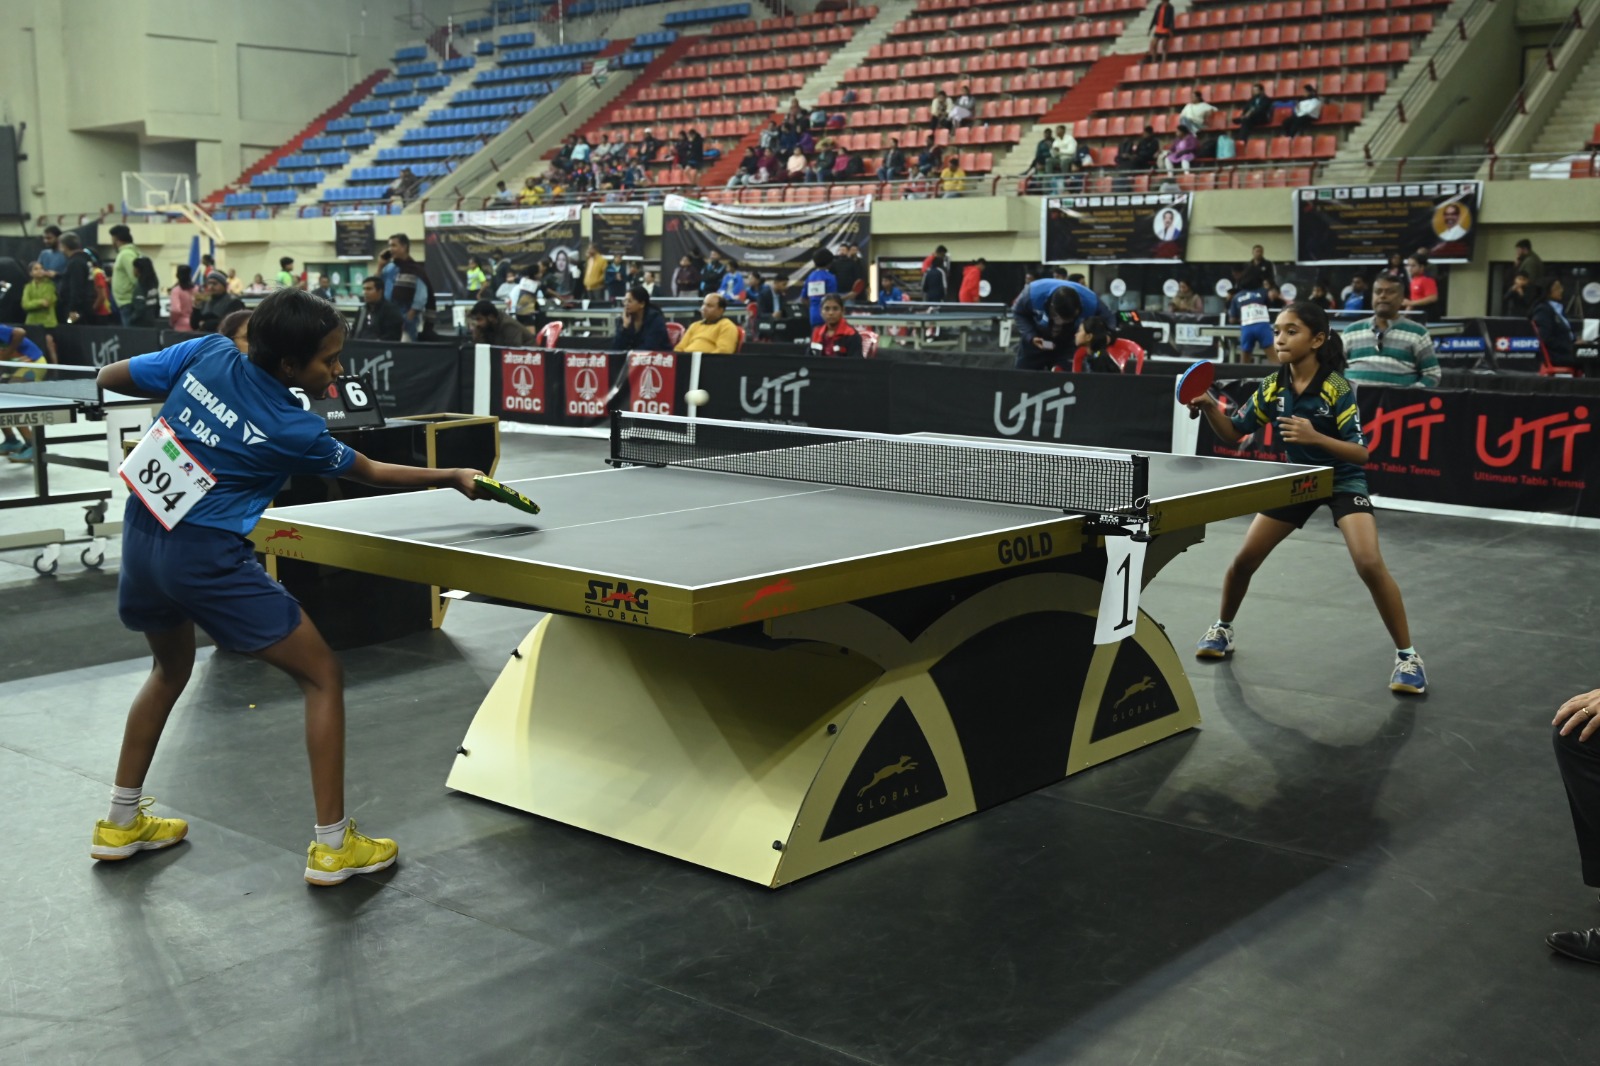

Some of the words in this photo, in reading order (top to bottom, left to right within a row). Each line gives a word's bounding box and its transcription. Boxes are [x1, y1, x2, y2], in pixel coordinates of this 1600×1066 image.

[1452, 340, 1480, 348] BANK
[182, 372, 238, 429] TIBHAR
[345, 382, 368, 406] 6
[740, 367, 810, 416] UTT
[506, 396, 541, 411] ONGC
[569, 401, 604, 414] ONGC
[633, 400, 670, 415] NGC
[993, 381, 1076, 438] UTT
[41, 411, 54, 425] 16
[178, 407, 191, 428] D.
[190, 418, 221, 448] DAS
[1475, 405, 1591, 473] UTT
[1254, 450, 1278, 460] Table
[1382, 462, 1408, 473] Table
[1410, 464, 1441, 477] Tennis
[1474, 471, 1518, 484] Ultimate
[1522, 475, 1549, 486] Table
[1552, 478, 1585, 489] Tennis
[138, 458, 187, 513] 894
[265, 546, 305, 559] GLOBAL
[998, 532, 1053, 564] GOLD
[585, 580, 648, 614] STAG
[1114, 553, 1133, 631] 1
[585, 605, 648, 625] GLOBAL
[1112, 702, 1157, 722] GLOBAL
[856, 785, 919, 813] GLOBAL
